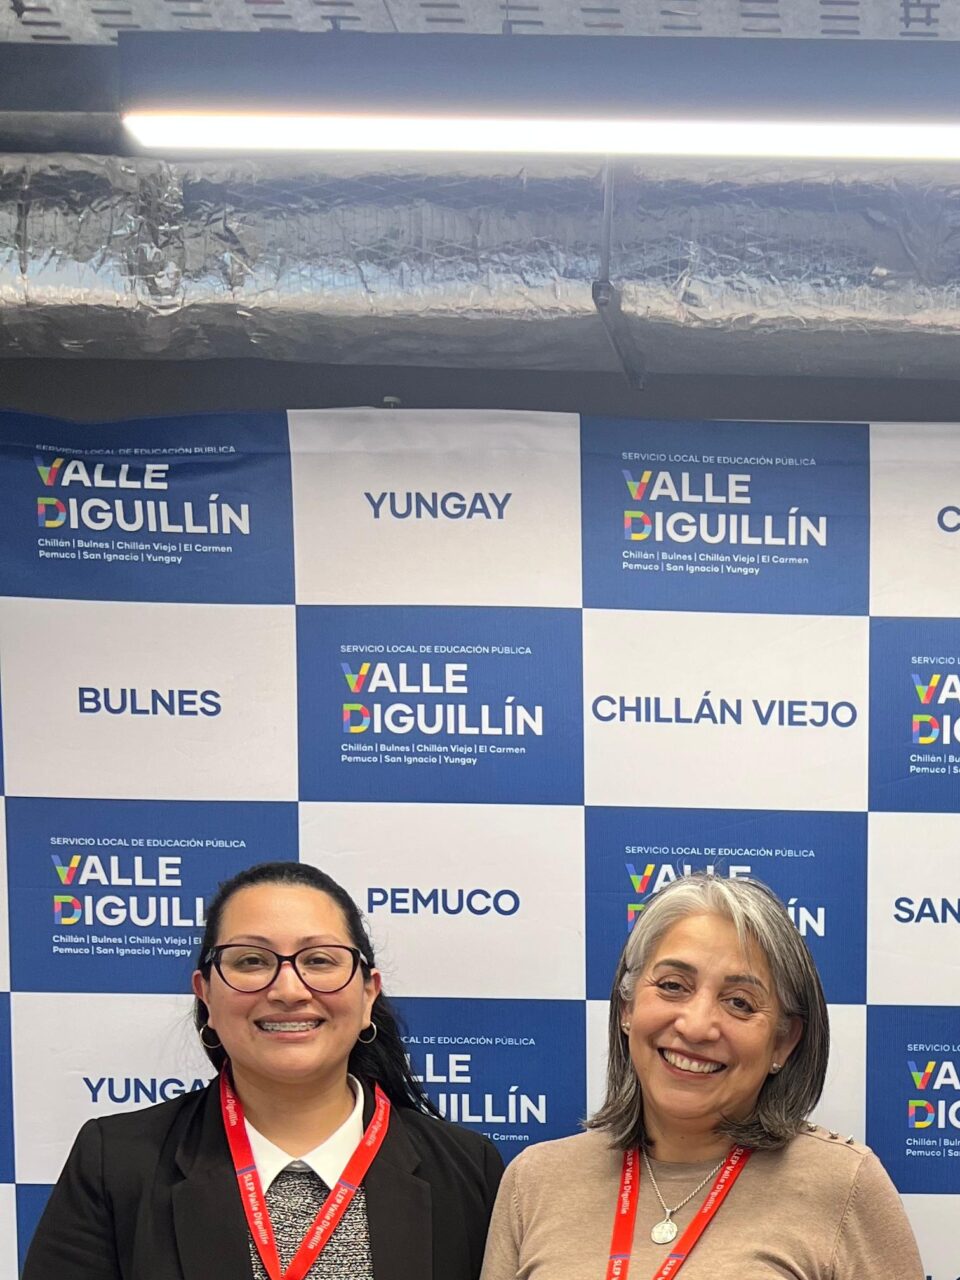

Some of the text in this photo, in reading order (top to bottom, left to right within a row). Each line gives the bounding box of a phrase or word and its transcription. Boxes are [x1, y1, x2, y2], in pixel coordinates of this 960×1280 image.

[622, 453, 667, 462] SERVICIO
[669, 454, 701, 463] LOCAL
[702, 455, 715, 464] DE
[34, 456, 169, 490] VALLE
[622, 470, 751, 504] VALLE
[37, 494, 250, 535] DIGUILLÍN
[364, 492, 512, 519] YUNGAY
[624, 507, 827, 547] DIGUILLÍN
[340, 644, 532, 655] SERVICIO LOCAL DE EDUCACIÓN PÚBLICA
[911, 656, 956, 665] SERVICIO
[340, 662, 468, 693] VALLE
[78, 687, 221, 716] BULNES
[592, 691, 857, 728] CHILLÁN VIEJO
[343, 696, 543, 735] DIGUILLÍN
[50, 837, 247, 848] SERVICIO LOCAL DE EDUCACIÓN PÚBLICA
[625, 846, 815, 858] SERVICIO LOCAL DE EDUCACIÓN PÚBLICA
[50, 855, 182, 886] VALLE
[367, 888, 520, 916] PEMUCO
[907, 1044, 951, 1052] SERVICIO
[83, 1077, 212, 1104] YUNGA
[729, 1146, 743, 1165] SLEP
[333, 1186, 347, 1204] SLEP
